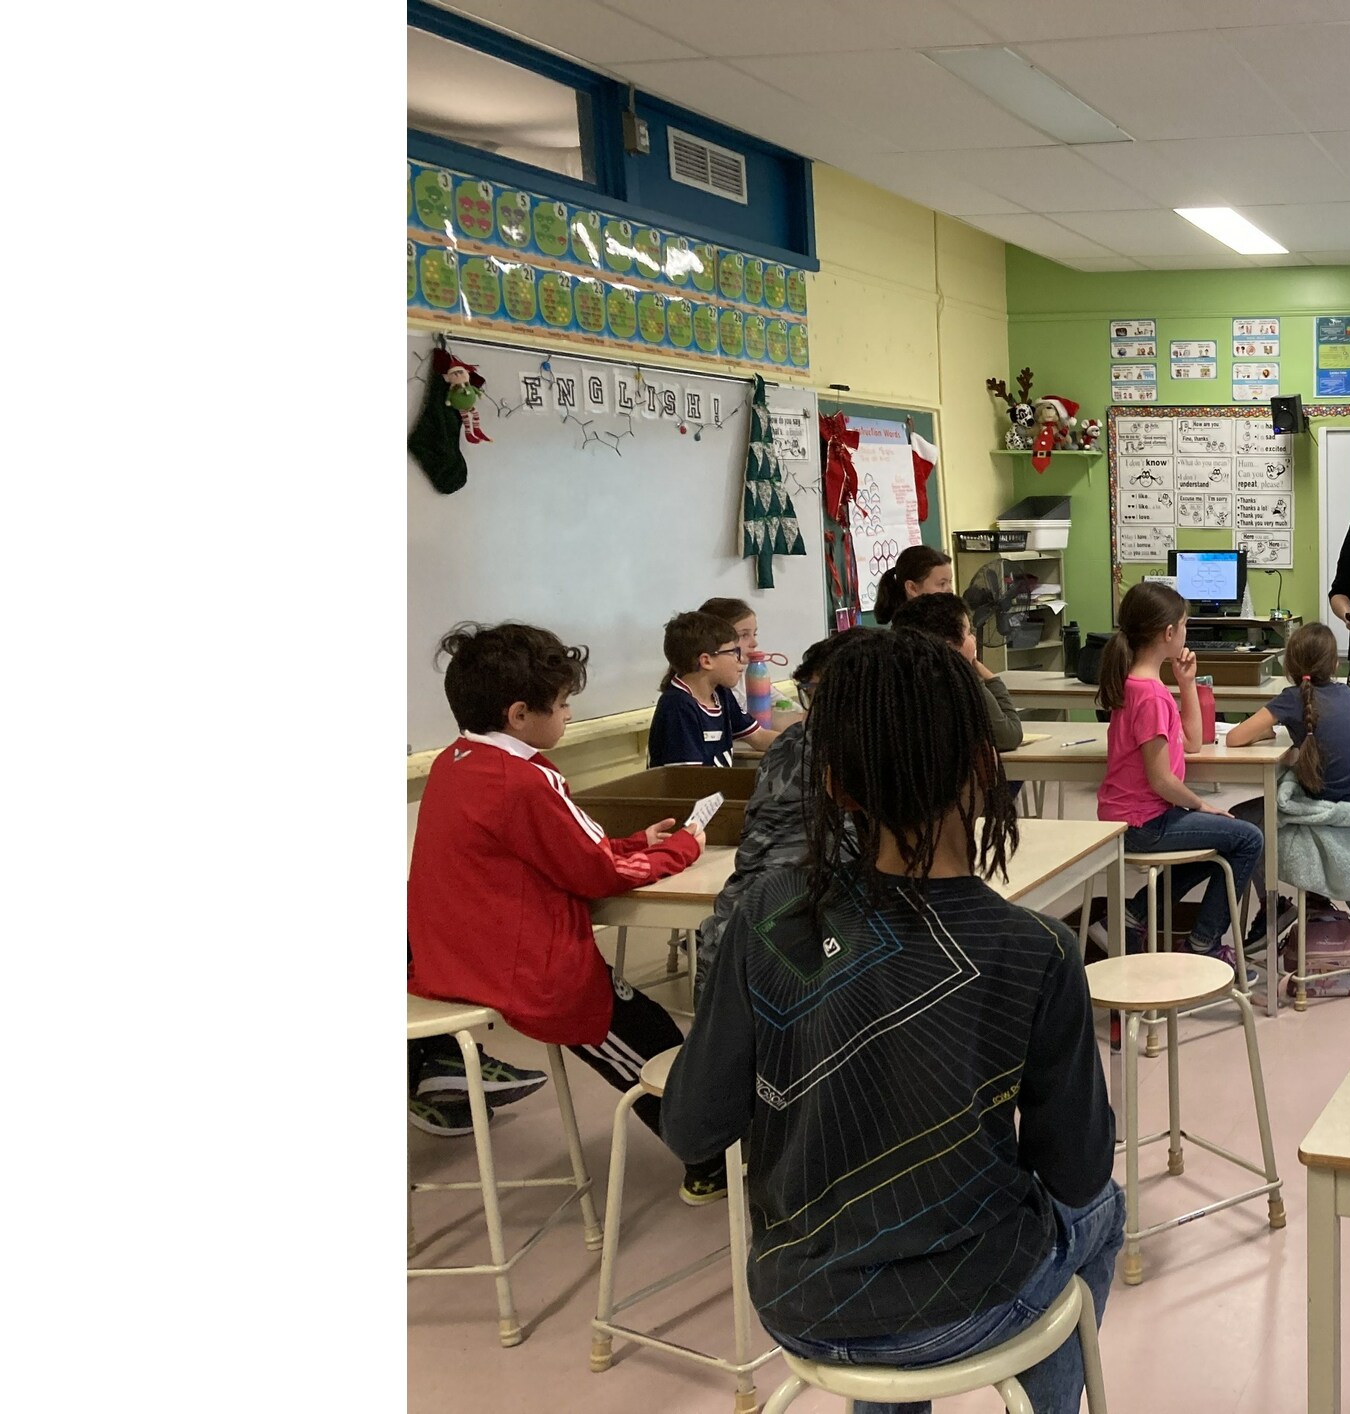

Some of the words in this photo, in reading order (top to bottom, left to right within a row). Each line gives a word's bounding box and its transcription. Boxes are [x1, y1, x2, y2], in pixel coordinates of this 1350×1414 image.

[486, 261, 497, 272] 20
[524, 269, 533, 280] 21
[560, 276, 570, 287] 22
[594, 282, 604, 294] 23
[625, 291, 635, 301] 24
[655, 296, 664, 307] 25
[682, 302, 690, 312] 26
[709, 308, 717, 318] 27
